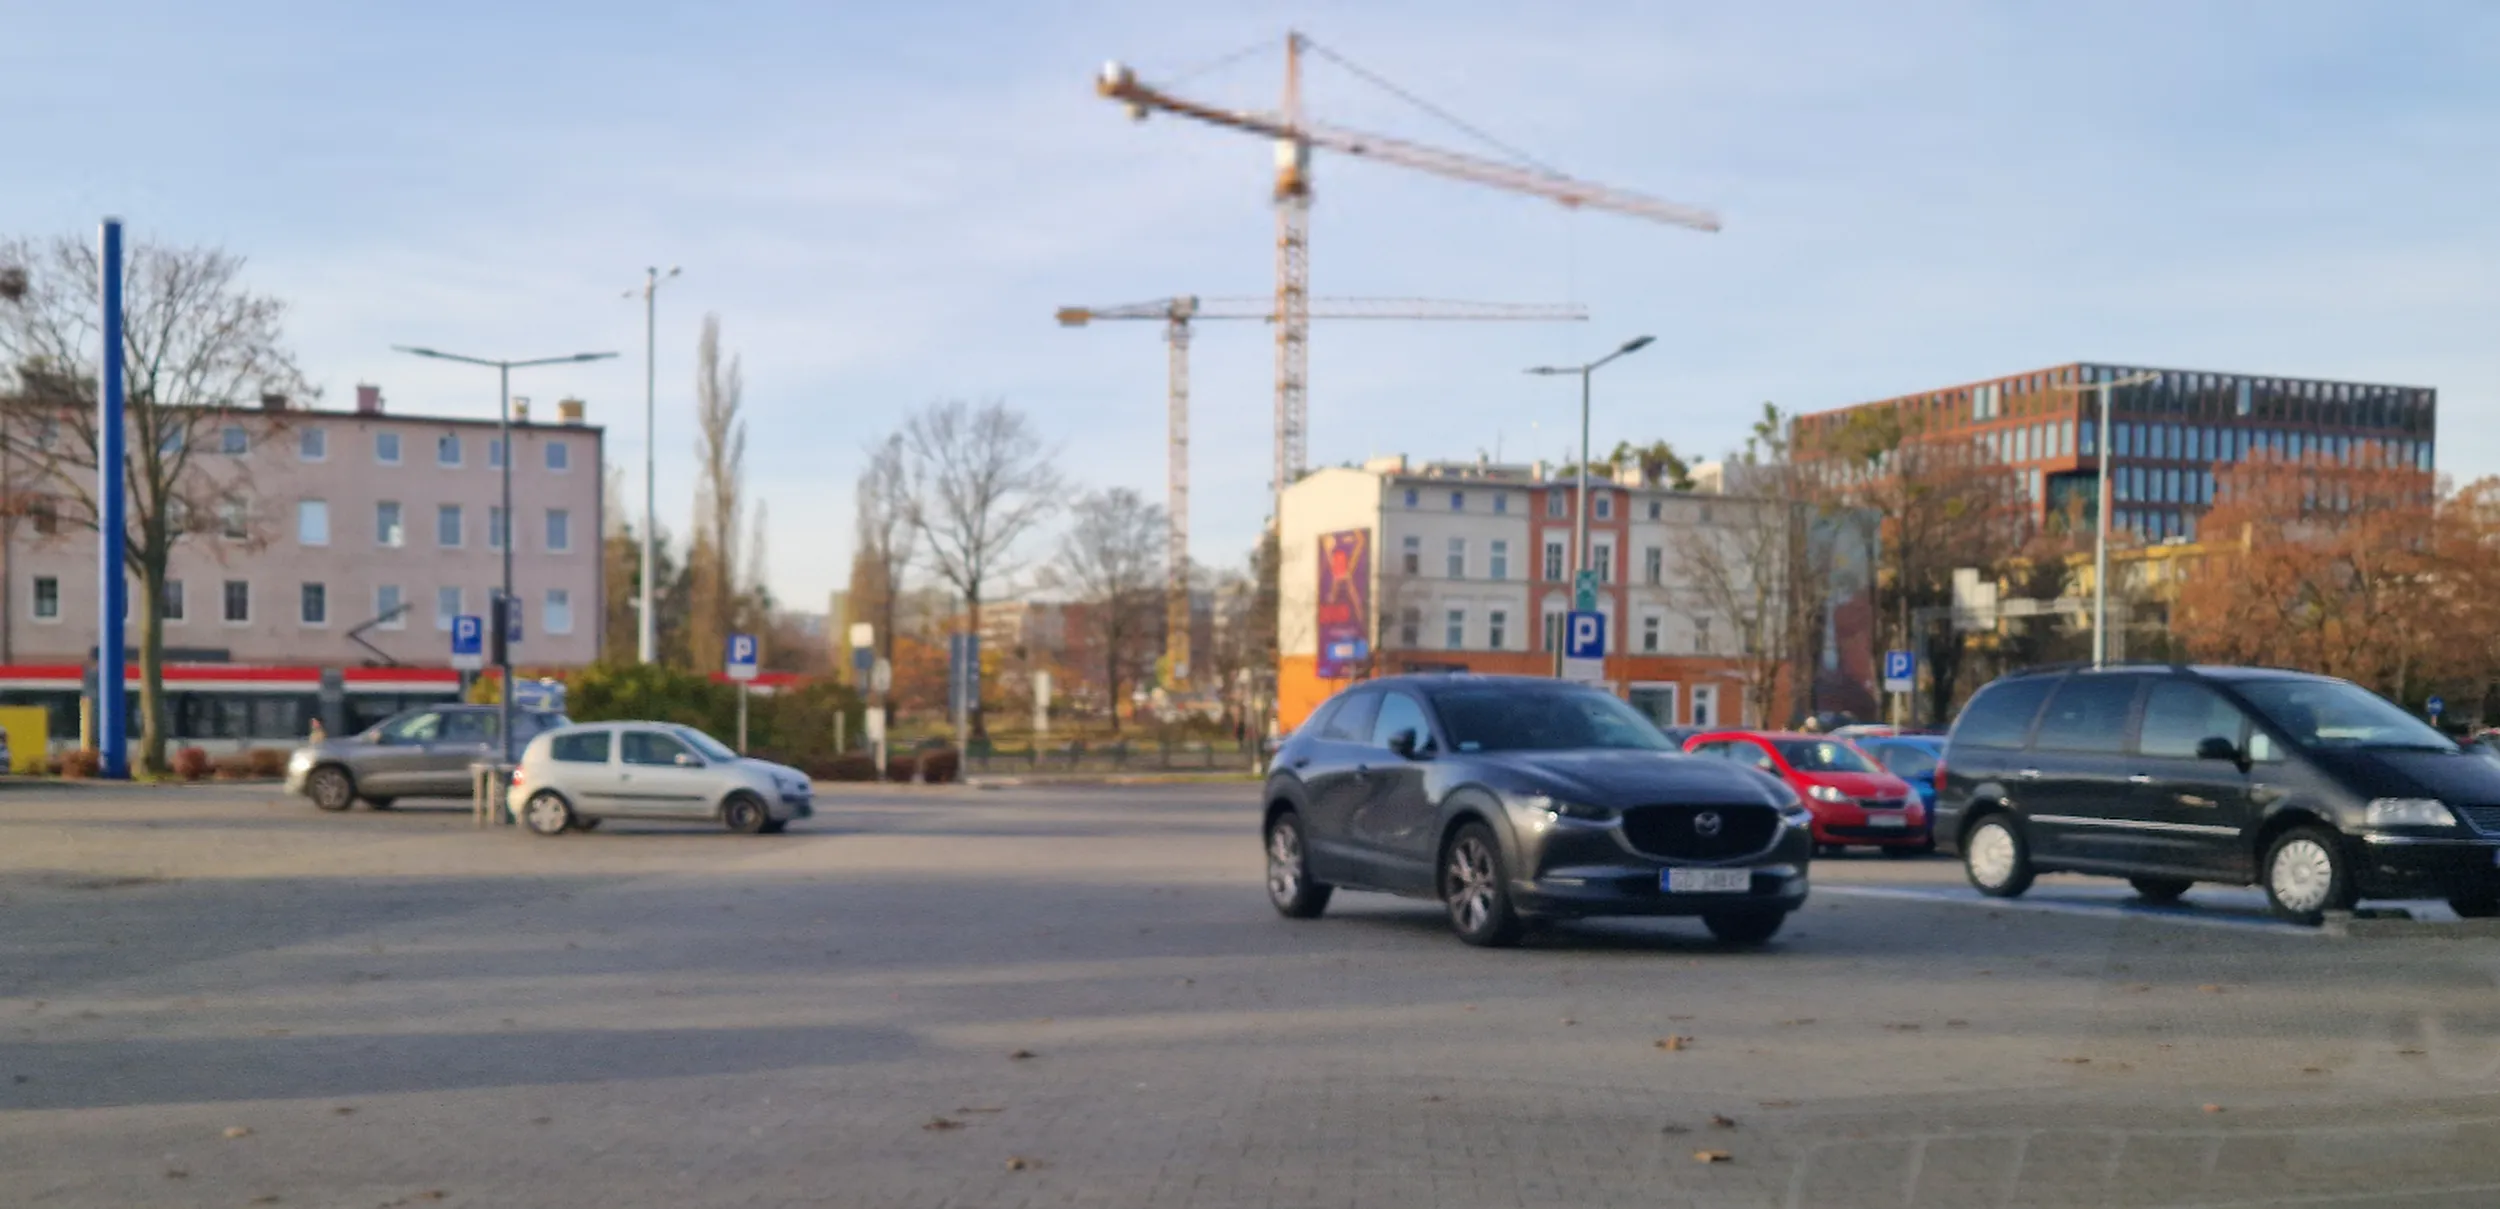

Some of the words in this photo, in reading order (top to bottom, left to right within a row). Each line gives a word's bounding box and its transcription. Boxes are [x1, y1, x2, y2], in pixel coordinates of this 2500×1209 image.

[459, 619, 475, 645] P
[1574, 617, 1597, 653] P
[735, 637, 751, 661] P
[1893, 654, 1907, 676] P
